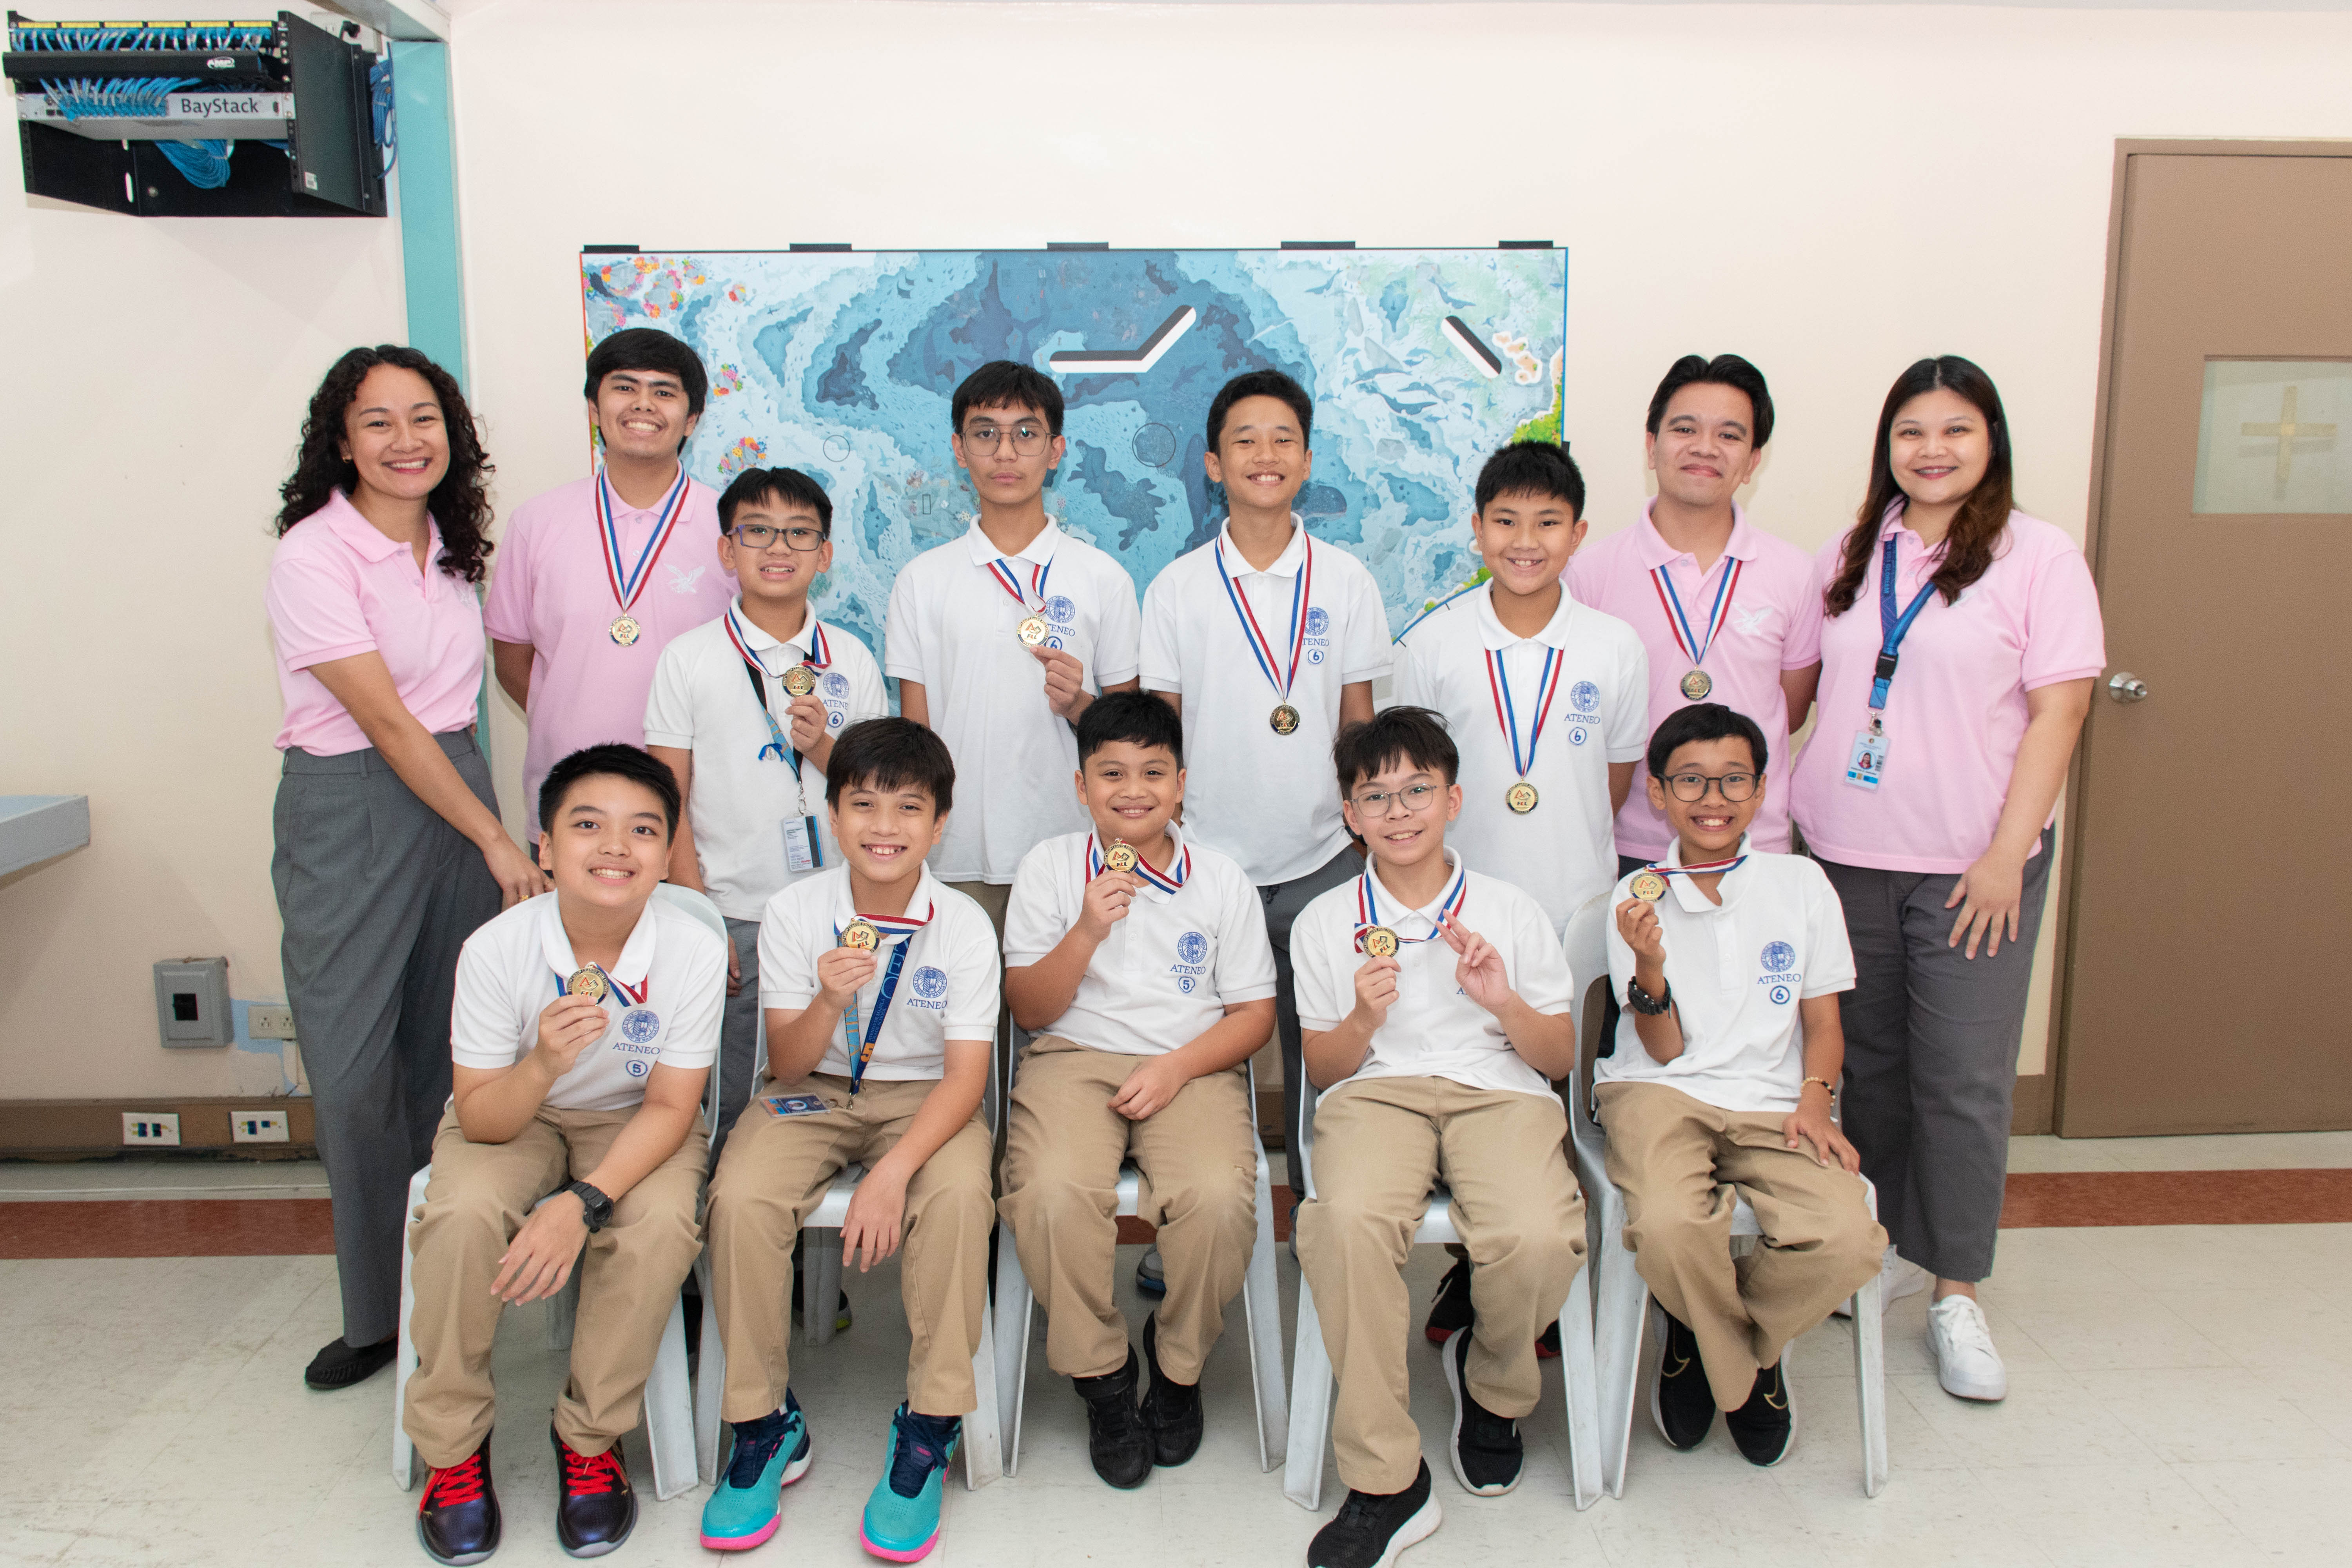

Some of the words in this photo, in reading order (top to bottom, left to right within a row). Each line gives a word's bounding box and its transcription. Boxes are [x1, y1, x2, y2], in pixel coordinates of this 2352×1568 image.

[181, 98, 259, 118] BayStack
[1047, 624, 1075, 637] TENEO
[1302, 638, 1330, 646] TENEO
[1313, 651, 1319, 661] 6
[823, 699, 848, 710] ATENE
[832, 715, 839, 724] 6
[1564, 713, 1600, 724] ATENEO
[1574, 730, 1581, 741] 6
[1379, 944, 1390, 953] FLL
[1170, 964, 1206, 975] ATENEO
[1757, 973, 1801, 984] ATENEO
[1183, 980, 1190, 990] 5
[1775, 989, 1784, 1000] 6
[906, 998, 947, 1009] ATENEO
[612, 1042, 660, 1054] ATENEO
[632, 1063, 641, 1073] 5
